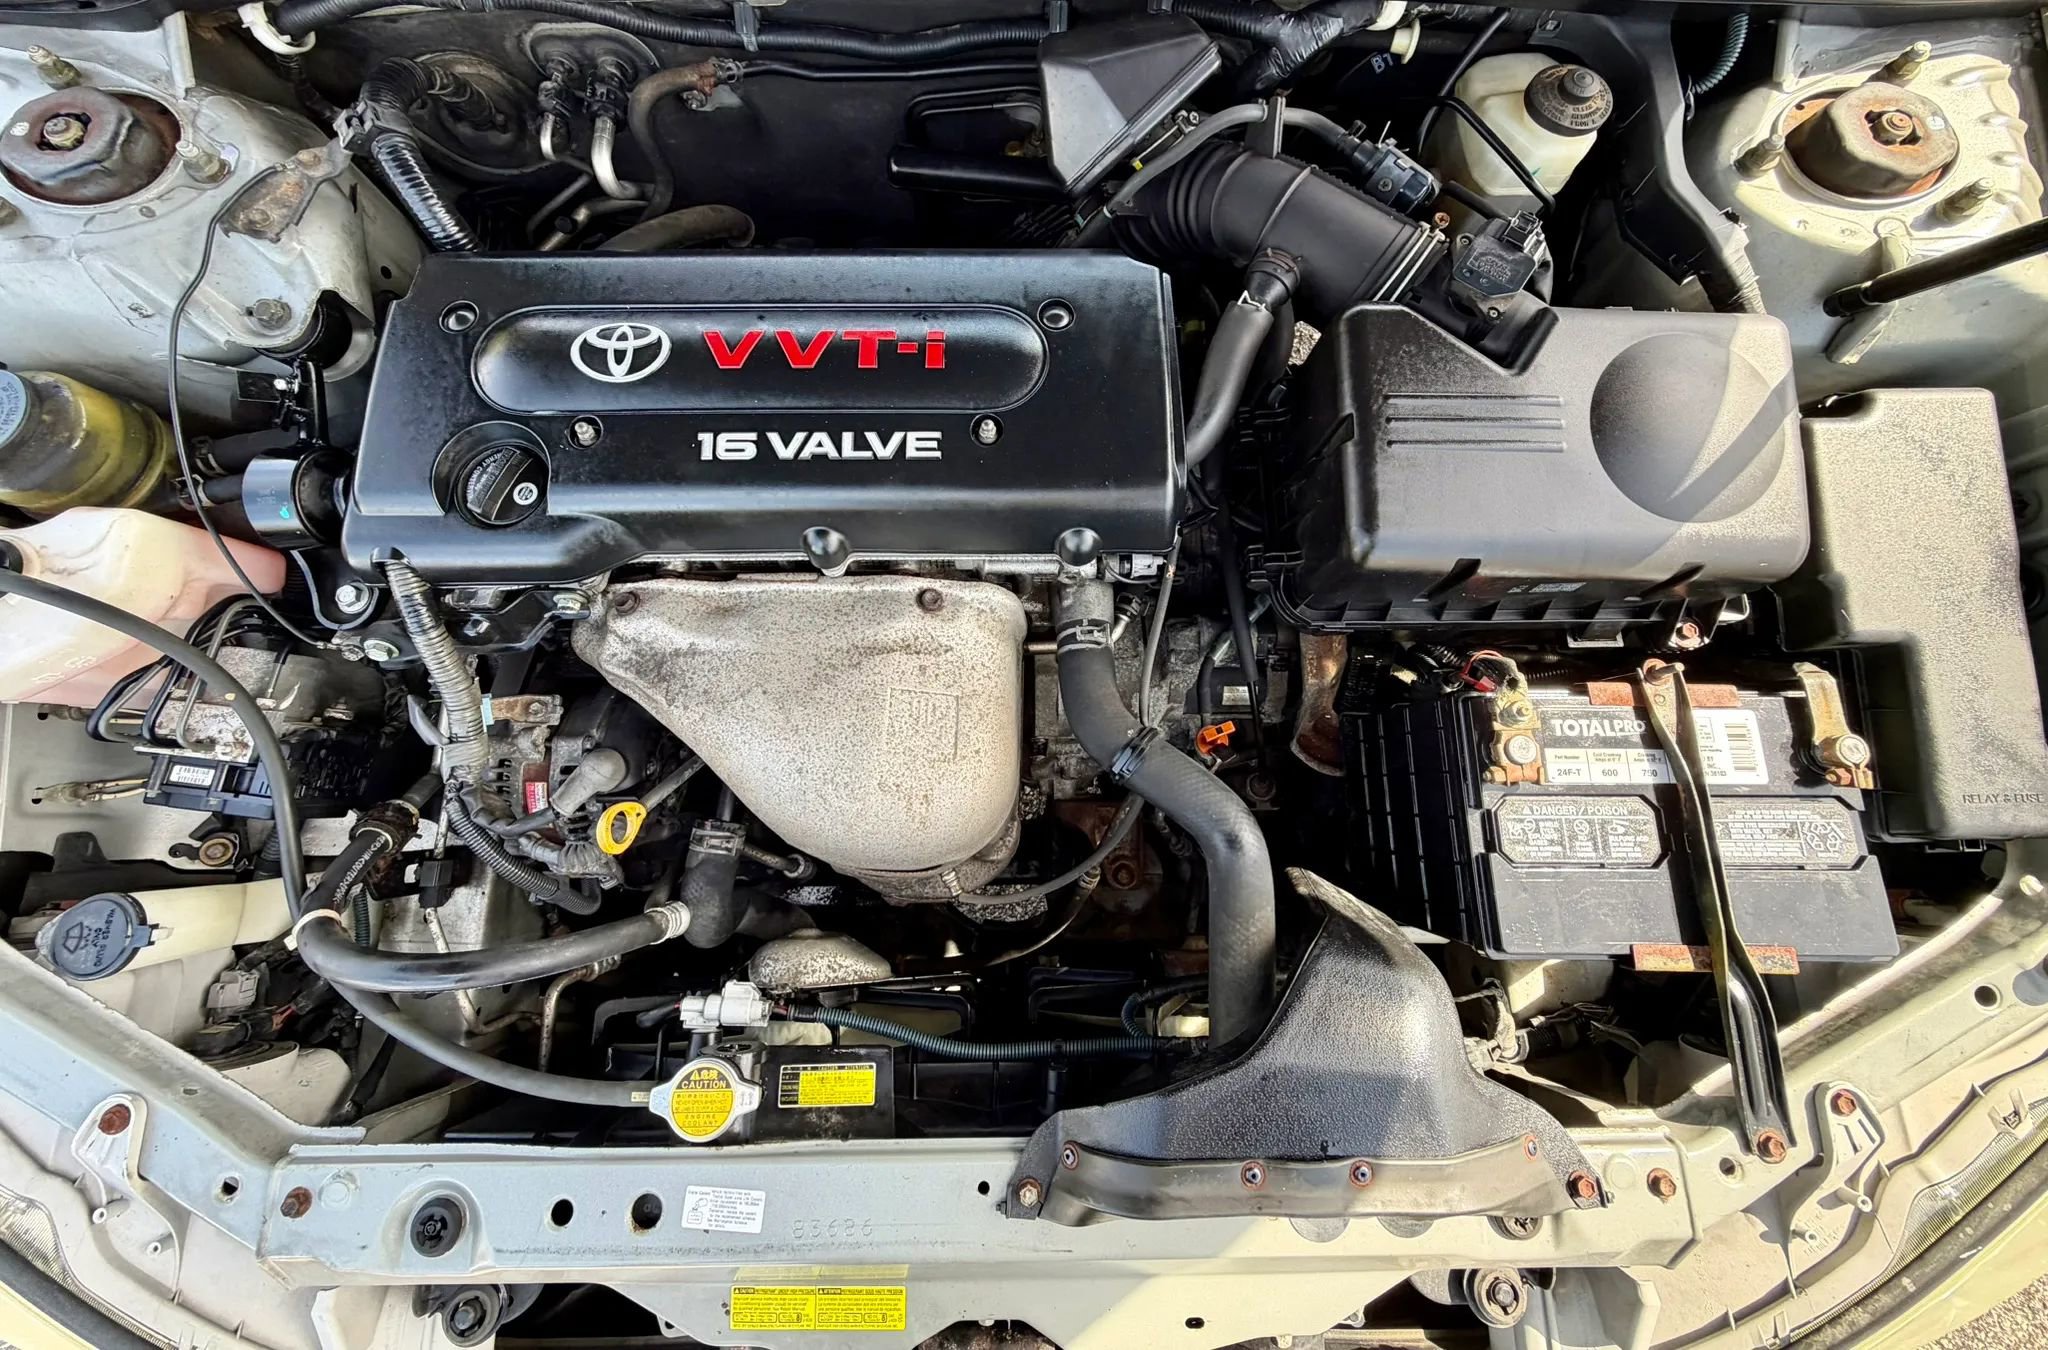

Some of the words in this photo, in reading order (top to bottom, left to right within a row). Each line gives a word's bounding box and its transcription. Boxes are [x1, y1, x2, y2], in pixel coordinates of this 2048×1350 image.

[703, 329, 946, 369] VVT-i
[697, 432, 758, 461] 16
[765, 432, 943, 461] VALVE
[1557, 768, 1582, 777] 24F-T
[1602, 769, 1618, 777] 600
[1962, 794, 2000, 804] RELAY
[2014, 793, 2045, 803] FUSE
[1533, 806, 1576, 815] DANGER
[1587, 806, 1628, 815] POISON
[682, 1080, 727, 1089] CAUTION
